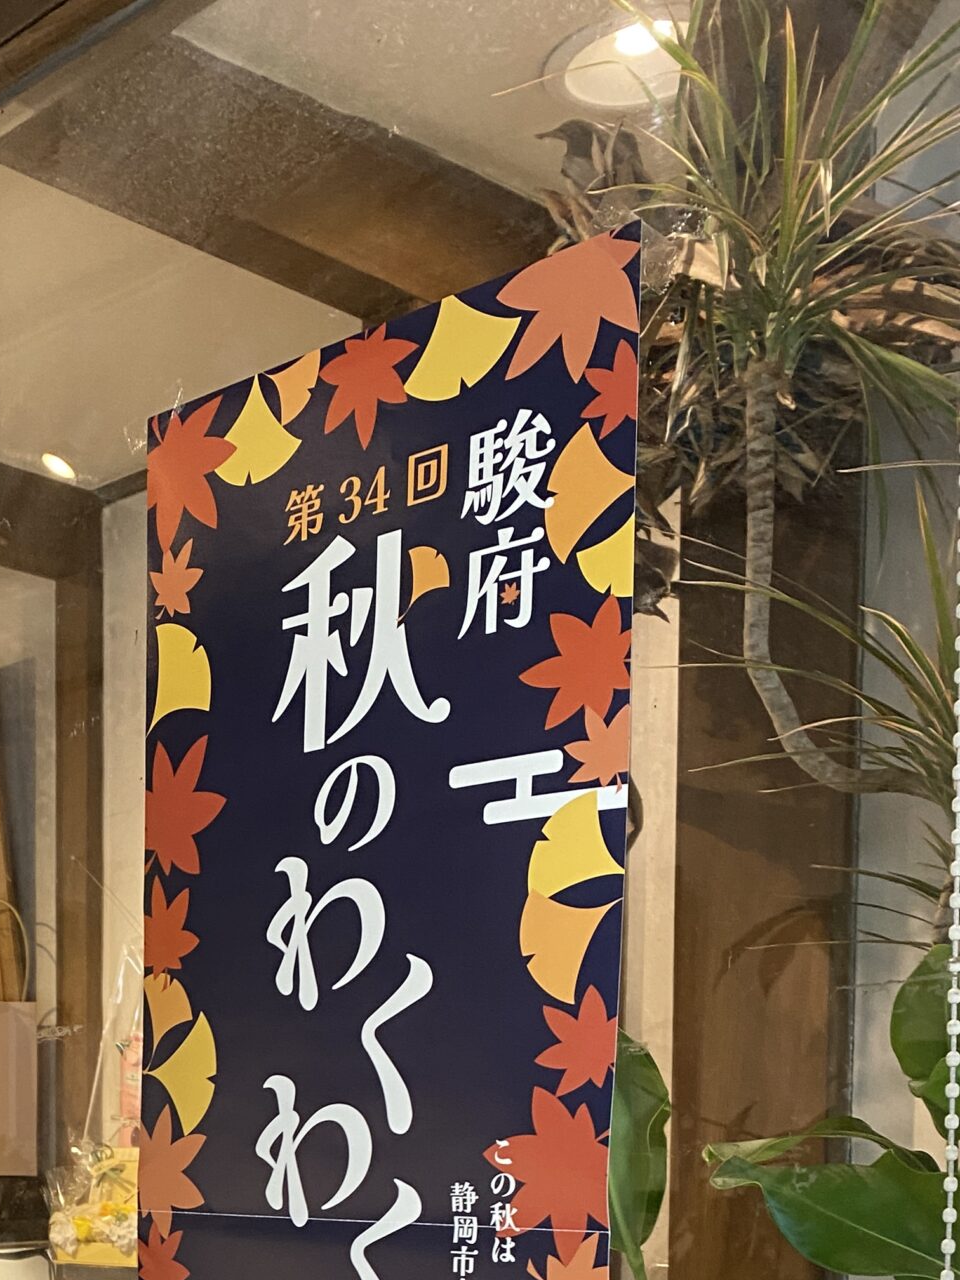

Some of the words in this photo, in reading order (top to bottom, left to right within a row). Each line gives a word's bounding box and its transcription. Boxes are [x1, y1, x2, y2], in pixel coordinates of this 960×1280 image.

[283, 443, 448, 546] 第34回
[456, 408, 556, 640] 駿府
[489, 1138, 521, 1264] この秋は
